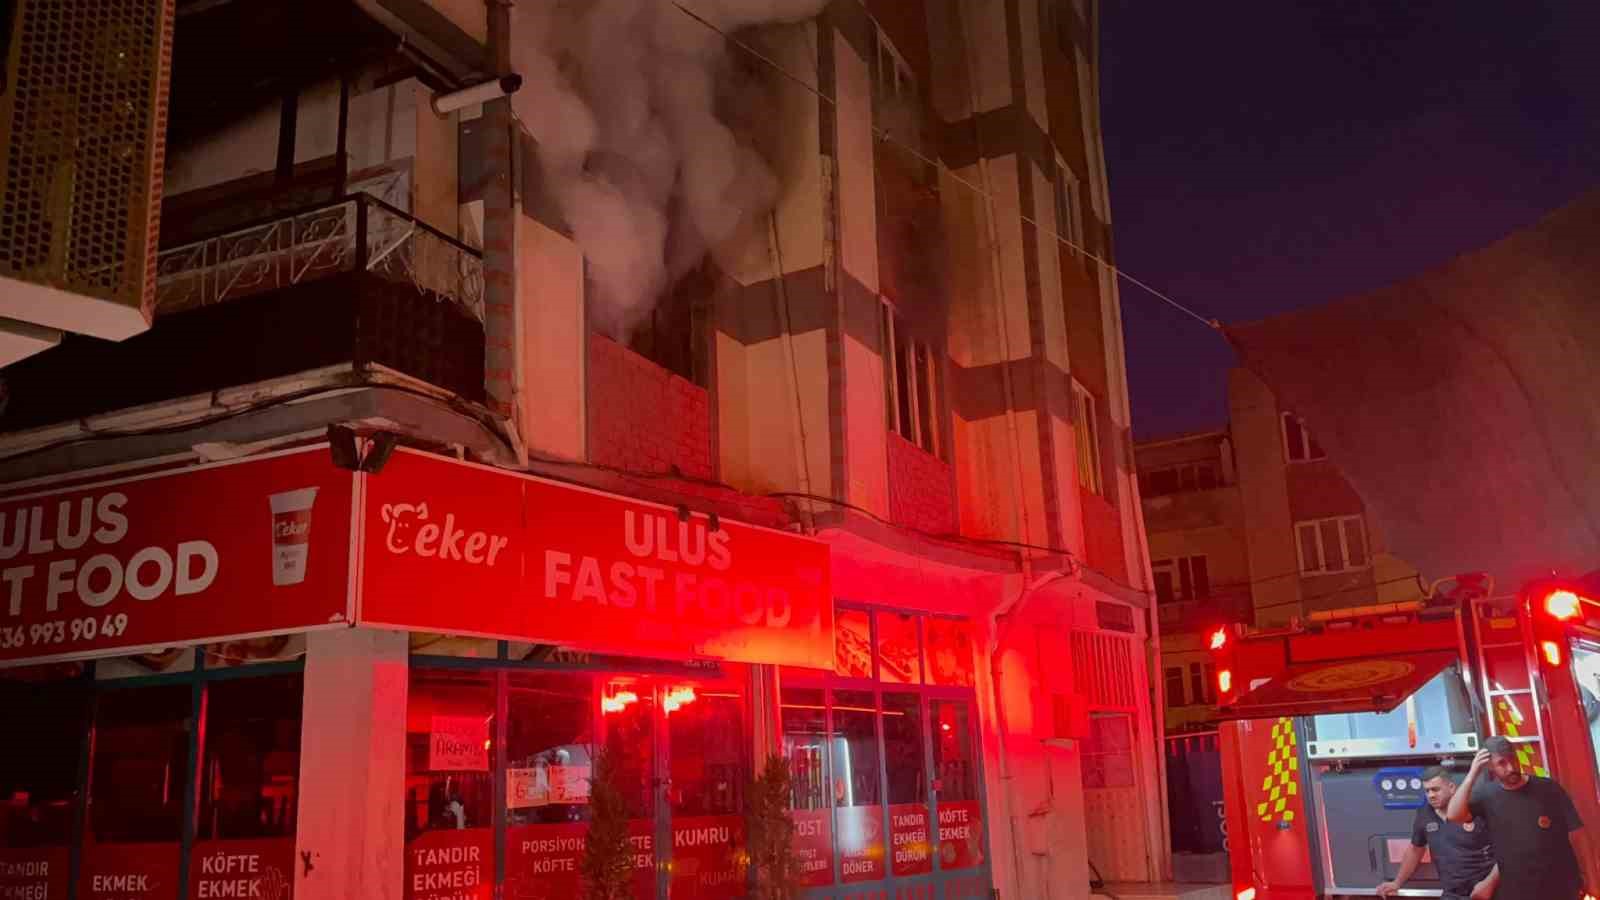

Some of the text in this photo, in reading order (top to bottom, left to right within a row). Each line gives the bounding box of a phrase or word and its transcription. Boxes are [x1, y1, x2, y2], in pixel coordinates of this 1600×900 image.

[0, 492, 128, 560] ULUS
[623, 509, 732, 570] ULUS
[46, 540, 219, 612] FOOD
[543, 549, 792, 627] FAST FOOD
[0, 612, 128, 649] 36 993 90 49
[892, 814, 924, 827] TANDIR
[939, 809, 968, 823] KÖFTE
[674, 827, 729, 848] KUMRU
[939, 826, 970, 841] EKMEK
[522, 836, 585, 854] PORSİYON
[202, 852, 260, 874] KÖFTE
[414, 846, 480, 867] TANDIR
[533, 857, 575, 874] KÖFTE
[413, 866, 480, 891] EKMEĞİ
[843, 860, 875, 876] DÖNER
[92, 874, 149, 892] EKMEK
[198, 879, 261, 899] EKMEK
